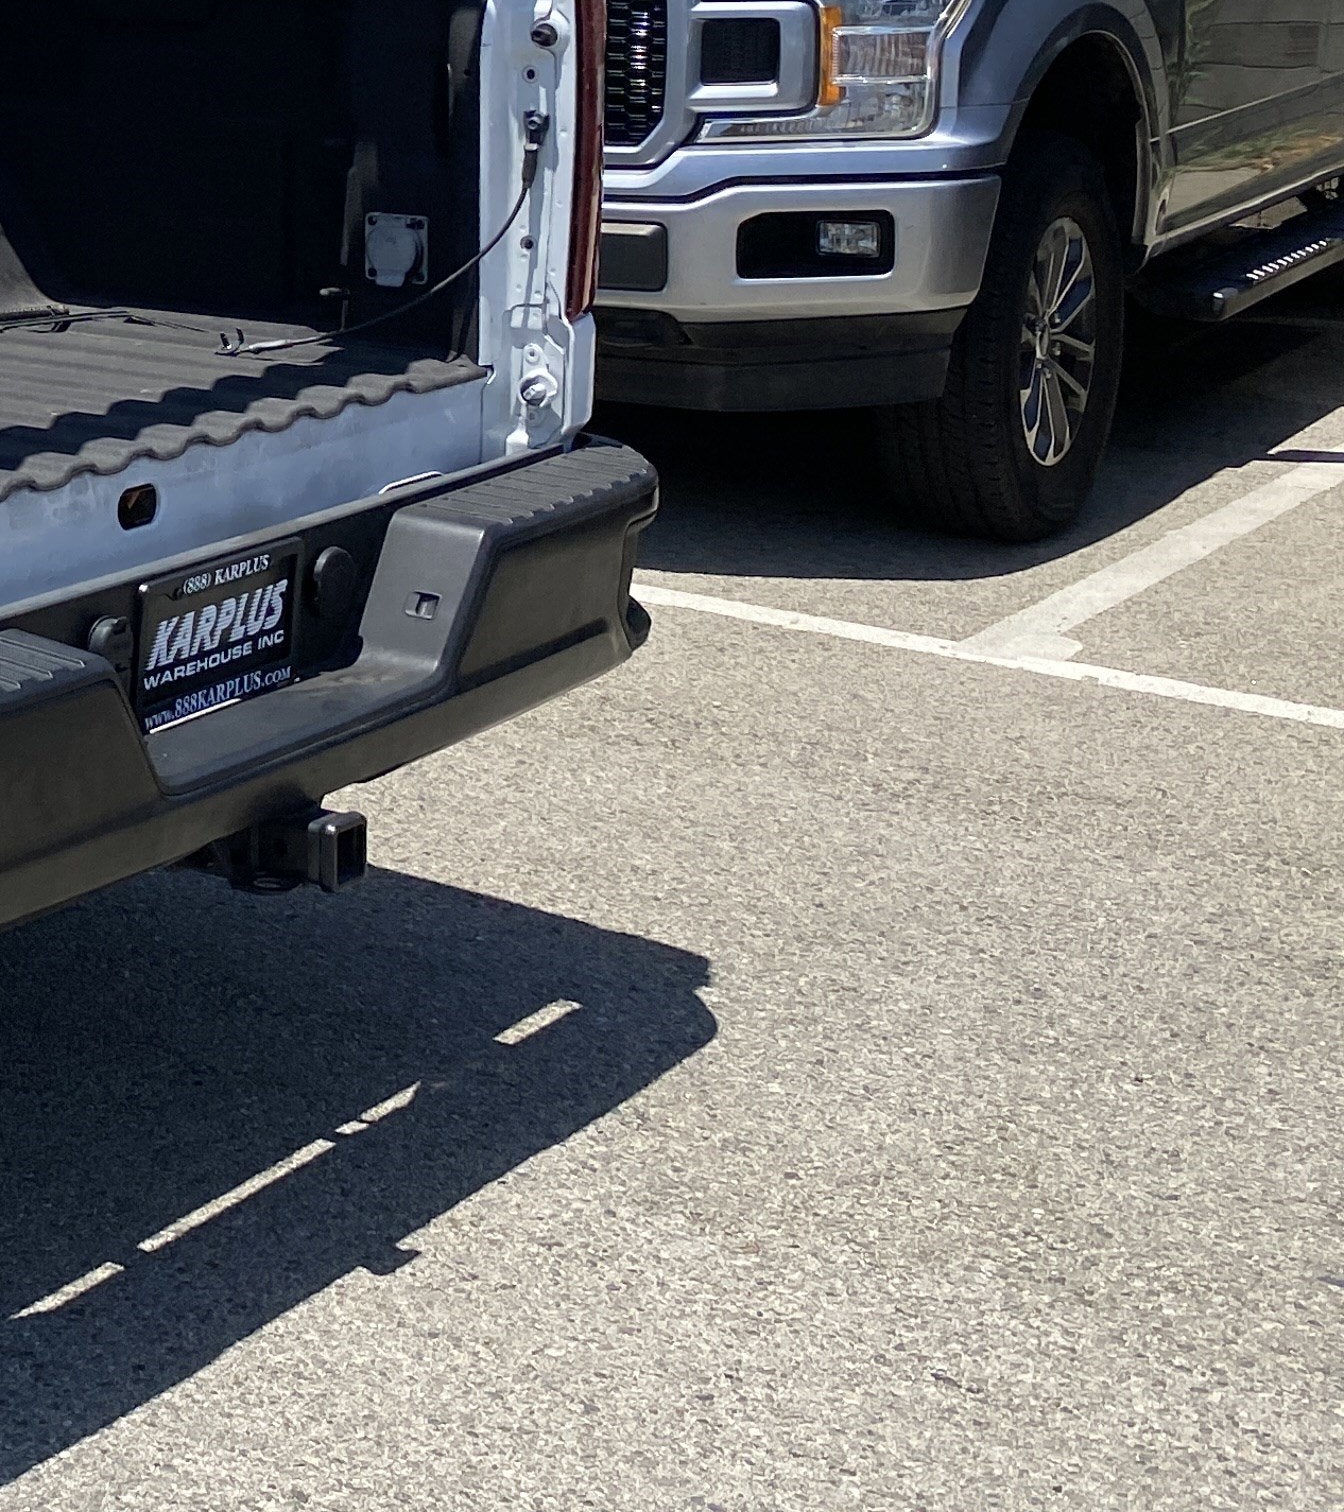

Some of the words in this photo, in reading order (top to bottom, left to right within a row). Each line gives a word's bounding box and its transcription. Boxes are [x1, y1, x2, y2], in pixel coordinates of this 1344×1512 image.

[182, 572, 212, 595] (888)
[214, 555, 270, 585] KARPLUS
[146, 579, 288, 671] KARPLUS
[144, 641, 252, 690] WAREHOUSE
[257, 630, 284, 650] INC
